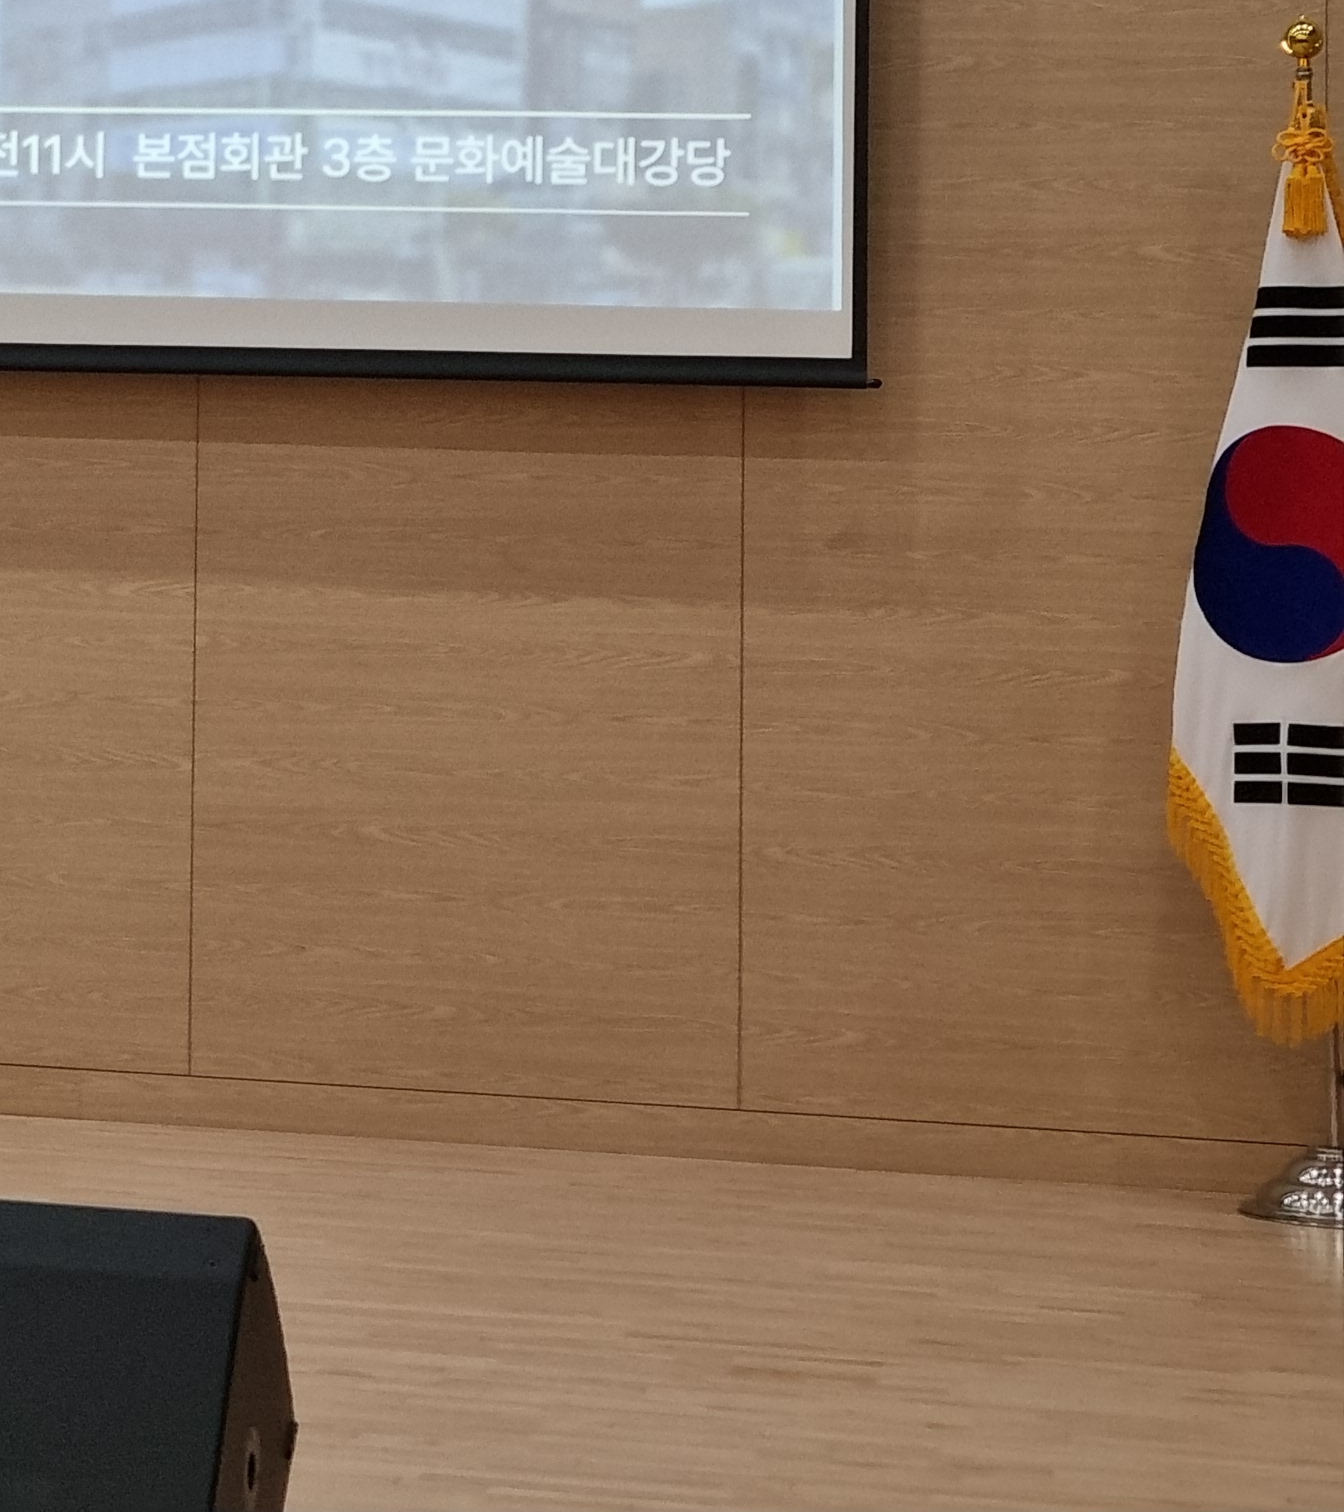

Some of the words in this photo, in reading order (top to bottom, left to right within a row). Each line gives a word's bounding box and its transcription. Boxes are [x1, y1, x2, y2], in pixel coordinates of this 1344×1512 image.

[132, 130, 309, 181] 본점회관
[322, 135, 397, 182] 3층
[410, 134, 732, 188] 문화예술대강당
